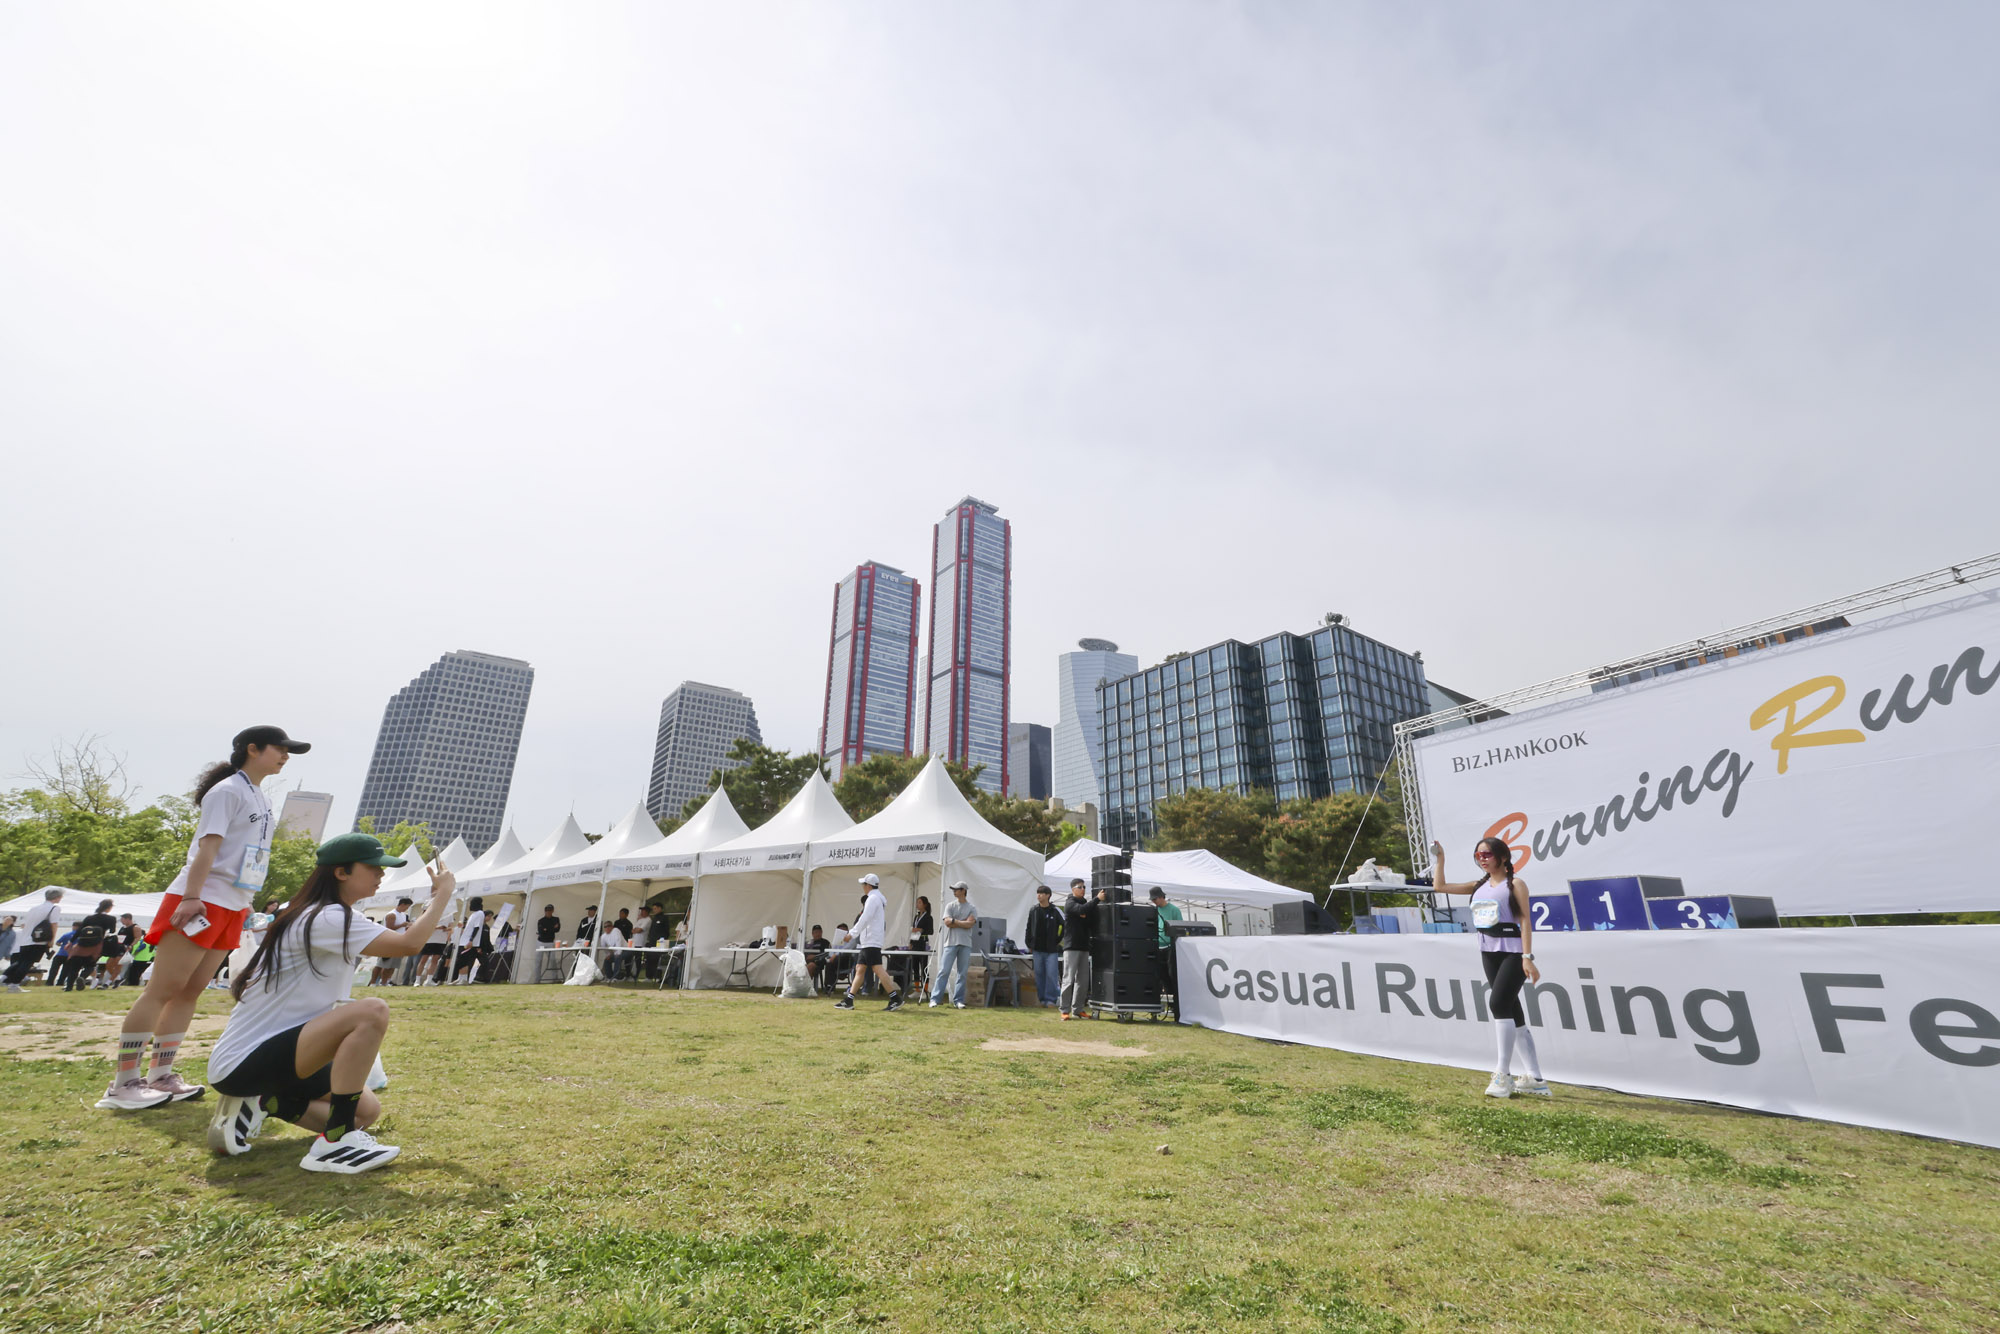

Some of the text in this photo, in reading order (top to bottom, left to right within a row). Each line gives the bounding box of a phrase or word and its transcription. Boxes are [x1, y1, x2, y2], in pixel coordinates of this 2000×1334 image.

[1483, 646, 2000, 874] Burning Run
[714, 856, 752, 868] 사회자대기실
[829, 846, 876, 860] 사회자대기실
[897, 844, 925, 852] BURNING
[925, 843, 939, 851] RUN
[625, 865, 642, 873] PRESS
[643, 864, 660, 872] ROOM
[1532, 901, 1554, 931] 2
[1599, 890, 1616, 921] 1
[1677, 900, 1706, 929] 3
[1206, 958, 1355, 1011] Casual
[1800, 972, 2000, 1067] Fe
